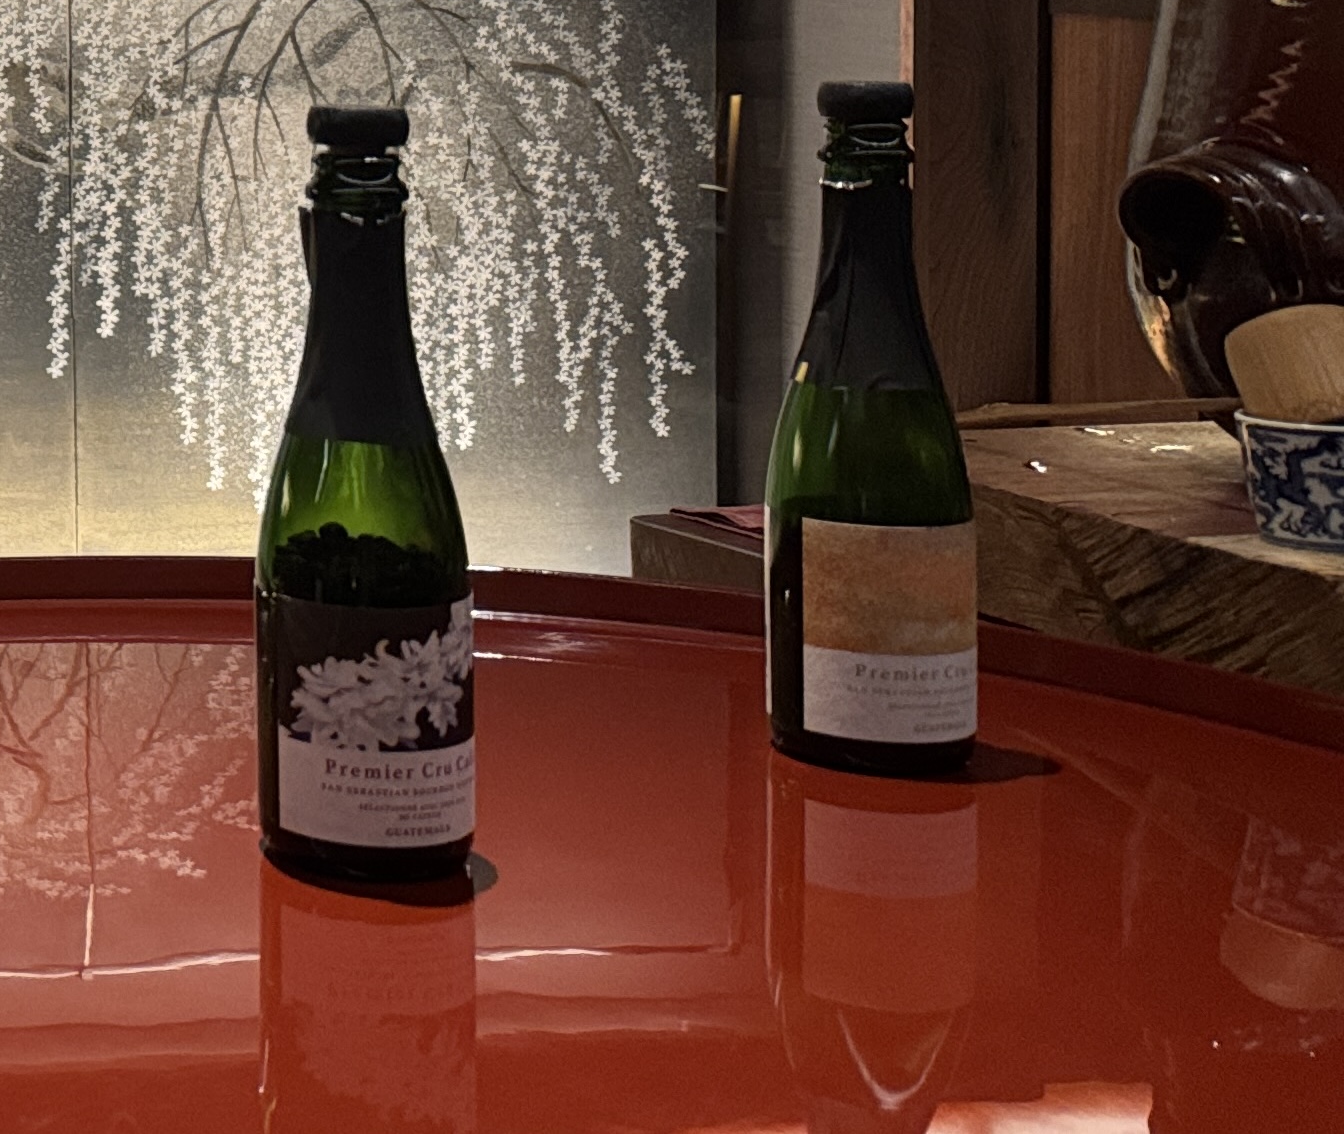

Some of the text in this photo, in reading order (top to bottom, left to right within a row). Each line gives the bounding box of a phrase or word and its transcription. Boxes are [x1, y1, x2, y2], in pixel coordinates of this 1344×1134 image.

[855, 663, 940, 681] Premier
[325, 758, 415, 780] Premier
[421, 761, 453, 779] Cru
